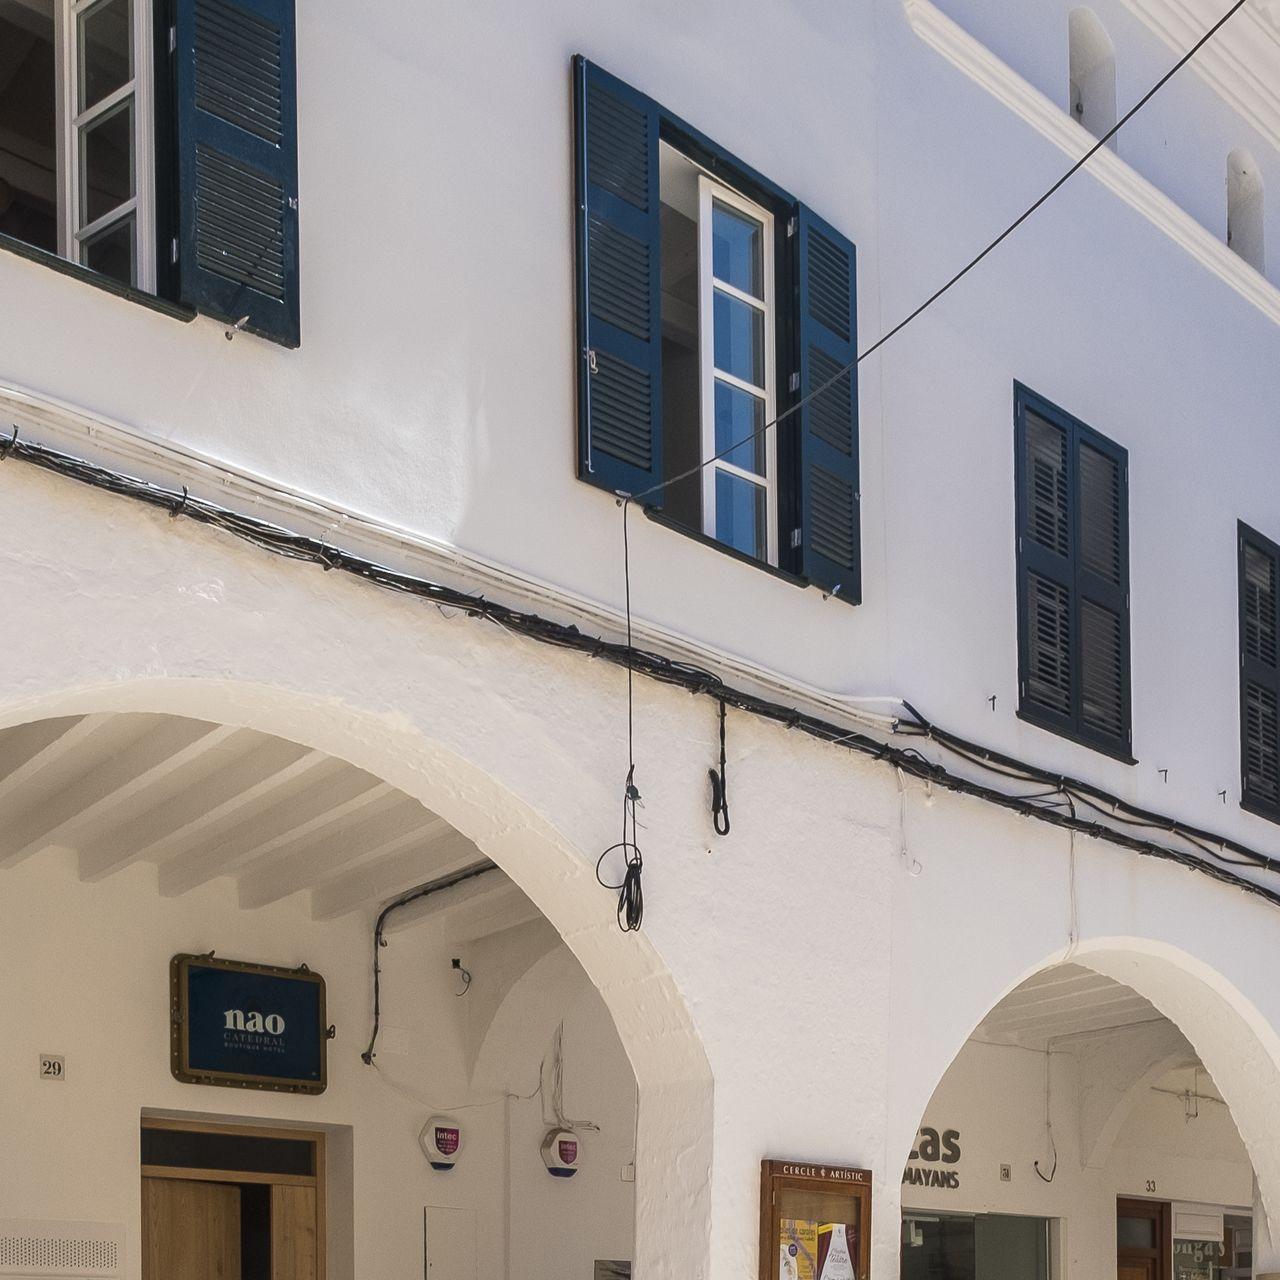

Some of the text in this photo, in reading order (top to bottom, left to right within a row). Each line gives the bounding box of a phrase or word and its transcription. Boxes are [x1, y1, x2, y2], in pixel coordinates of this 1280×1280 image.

[223, 1009, 286, 1035] nao
[223, 1032, 286, 1047] CATEDRAL
[42, 1060, 62, 1076] 29
[783, 1165, 864, 1181] CERCLE ARTÍSTIC
[1145, 1180, 1157, 1193] 33
